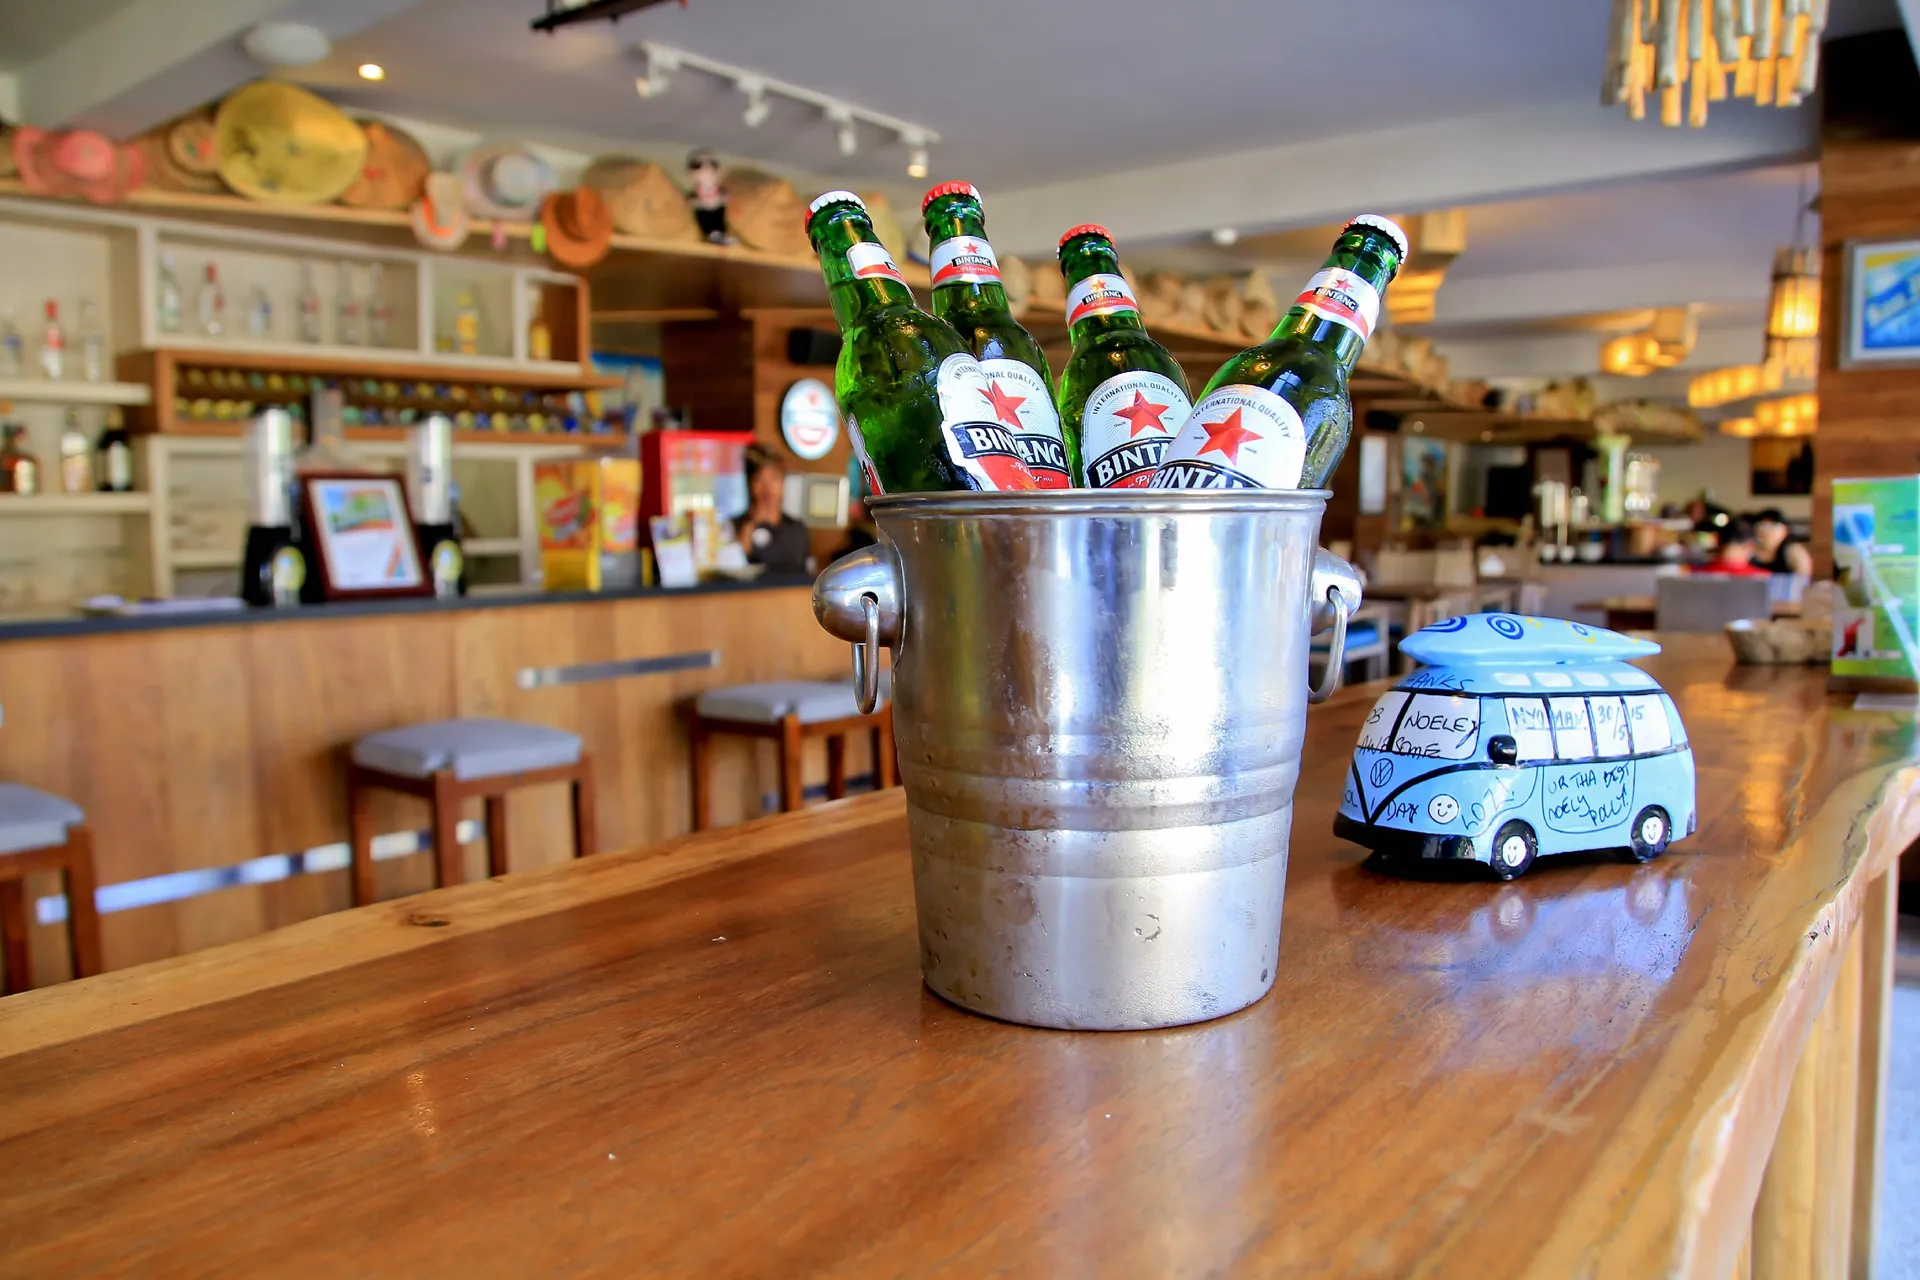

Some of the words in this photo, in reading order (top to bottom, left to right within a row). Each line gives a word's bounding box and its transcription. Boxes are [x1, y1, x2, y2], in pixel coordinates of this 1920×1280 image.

[955, 256, 991, 266] BINTANG
[1085, 290, 1122, 304] BINTANG
[1315, 288, 1357, 312] BINTANG
[1007, 371, 1040, 392] QUALITY
[1092, 382, 1148, 415] INTERNATIONAL
[1150, 382, 1182, 403] QUALITY
[1192, 397, 1257, 420] INTERNATIONAL
[1259, 404, 1291, 439] QUALITY
[1570, 769, 1597, 788] THA
